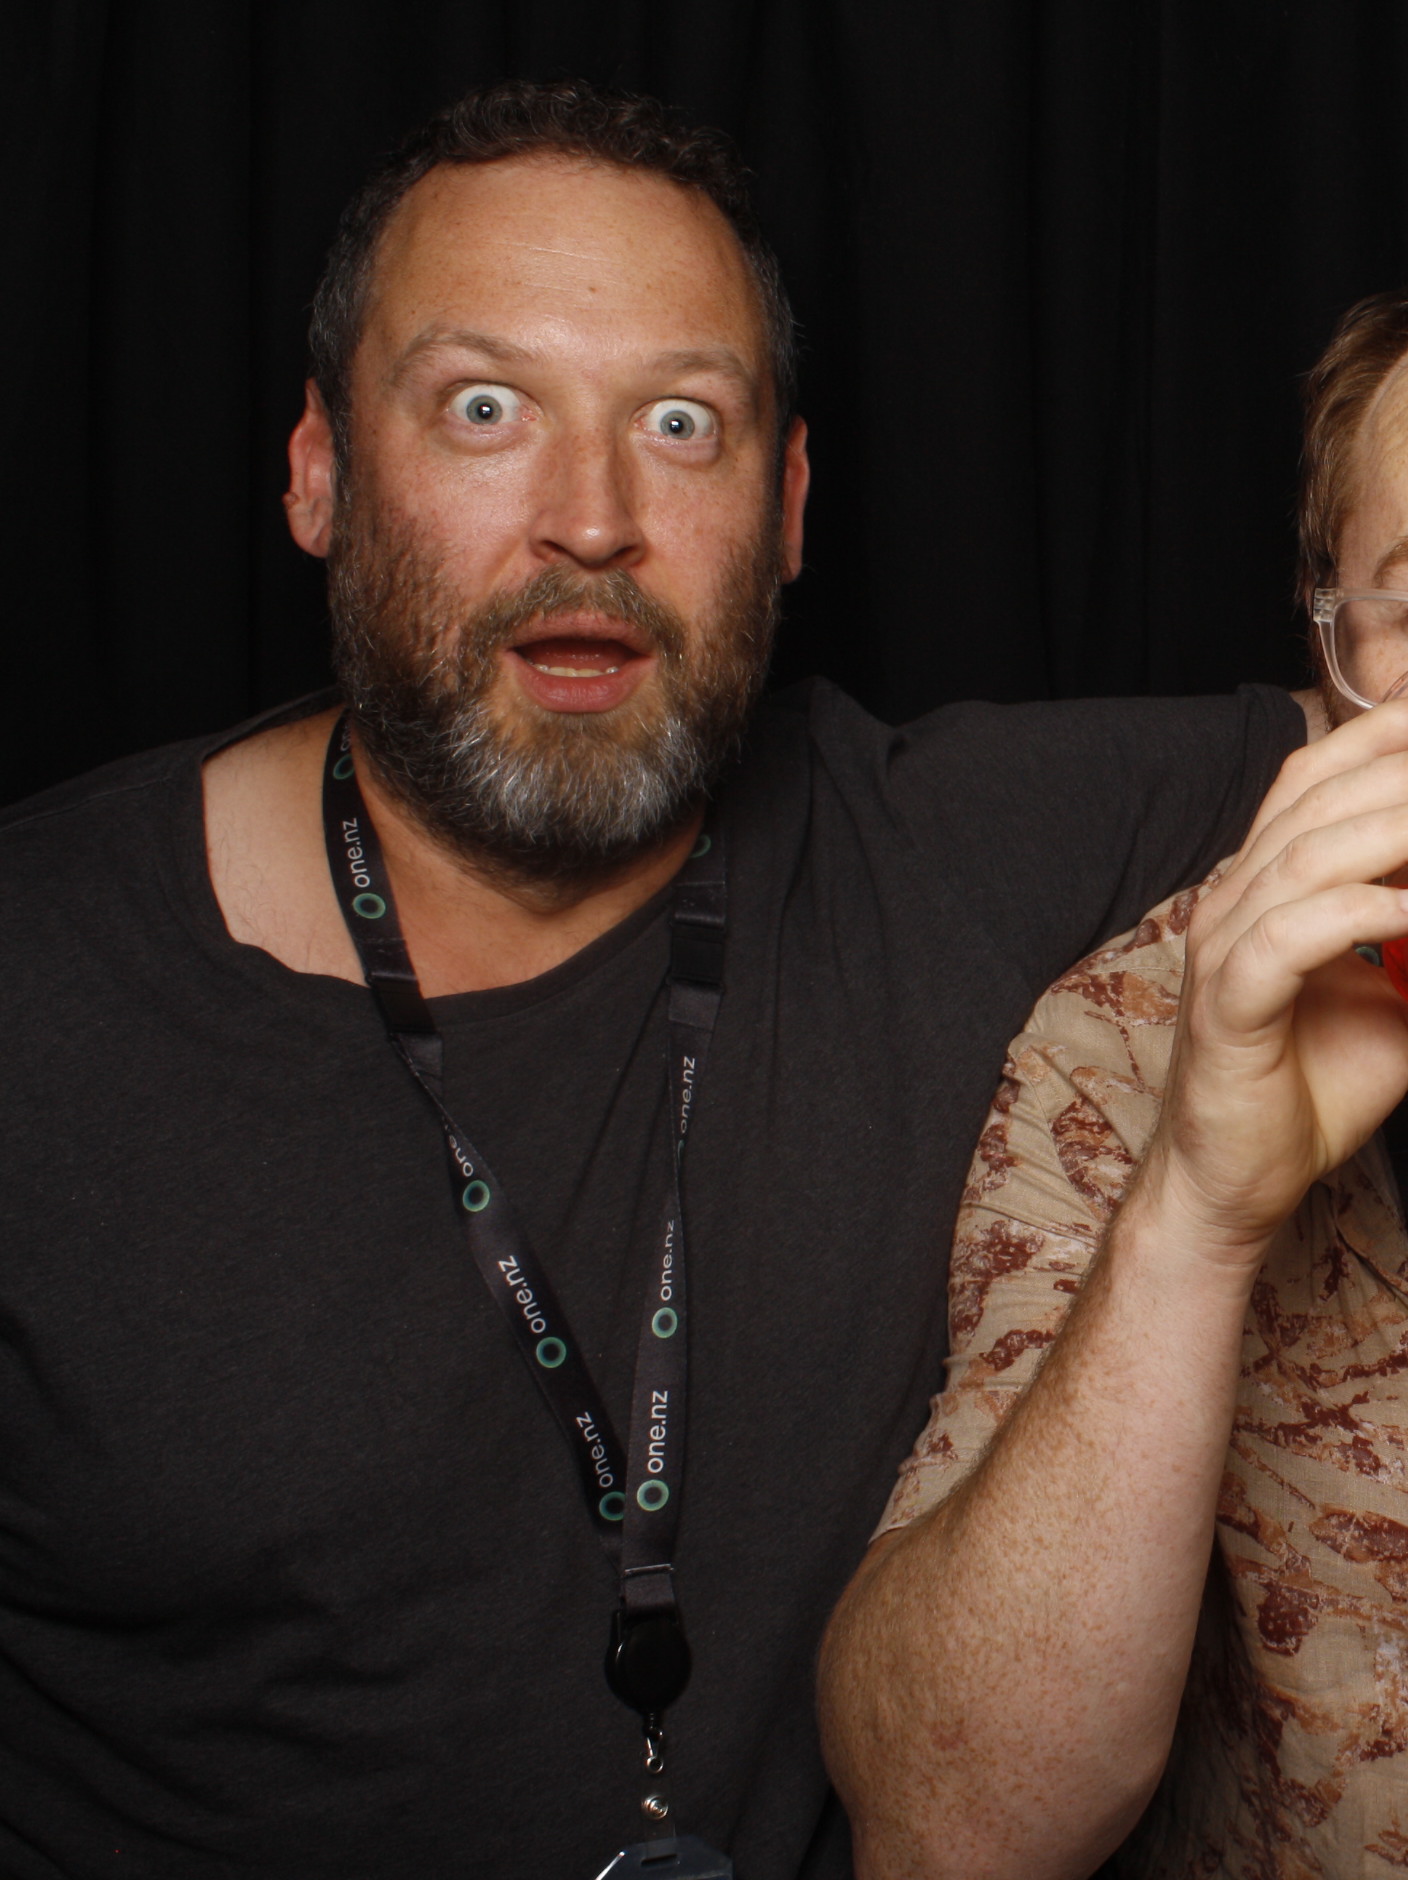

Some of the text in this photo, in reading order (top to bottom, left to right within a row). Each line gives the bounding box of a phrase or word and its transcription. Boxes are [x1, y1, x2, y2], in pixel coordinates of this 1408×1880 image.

[341, 817, 371, 889] one.nz
[680, 1056, 695, 1134] one.nz
[498, 1255, 546, 1334] one.nz
[660, 1219, 675, 1301] one.nz
[575, 1411, 614, 1488] one.nz
[647, 1390, 669, 1473] one.nz
